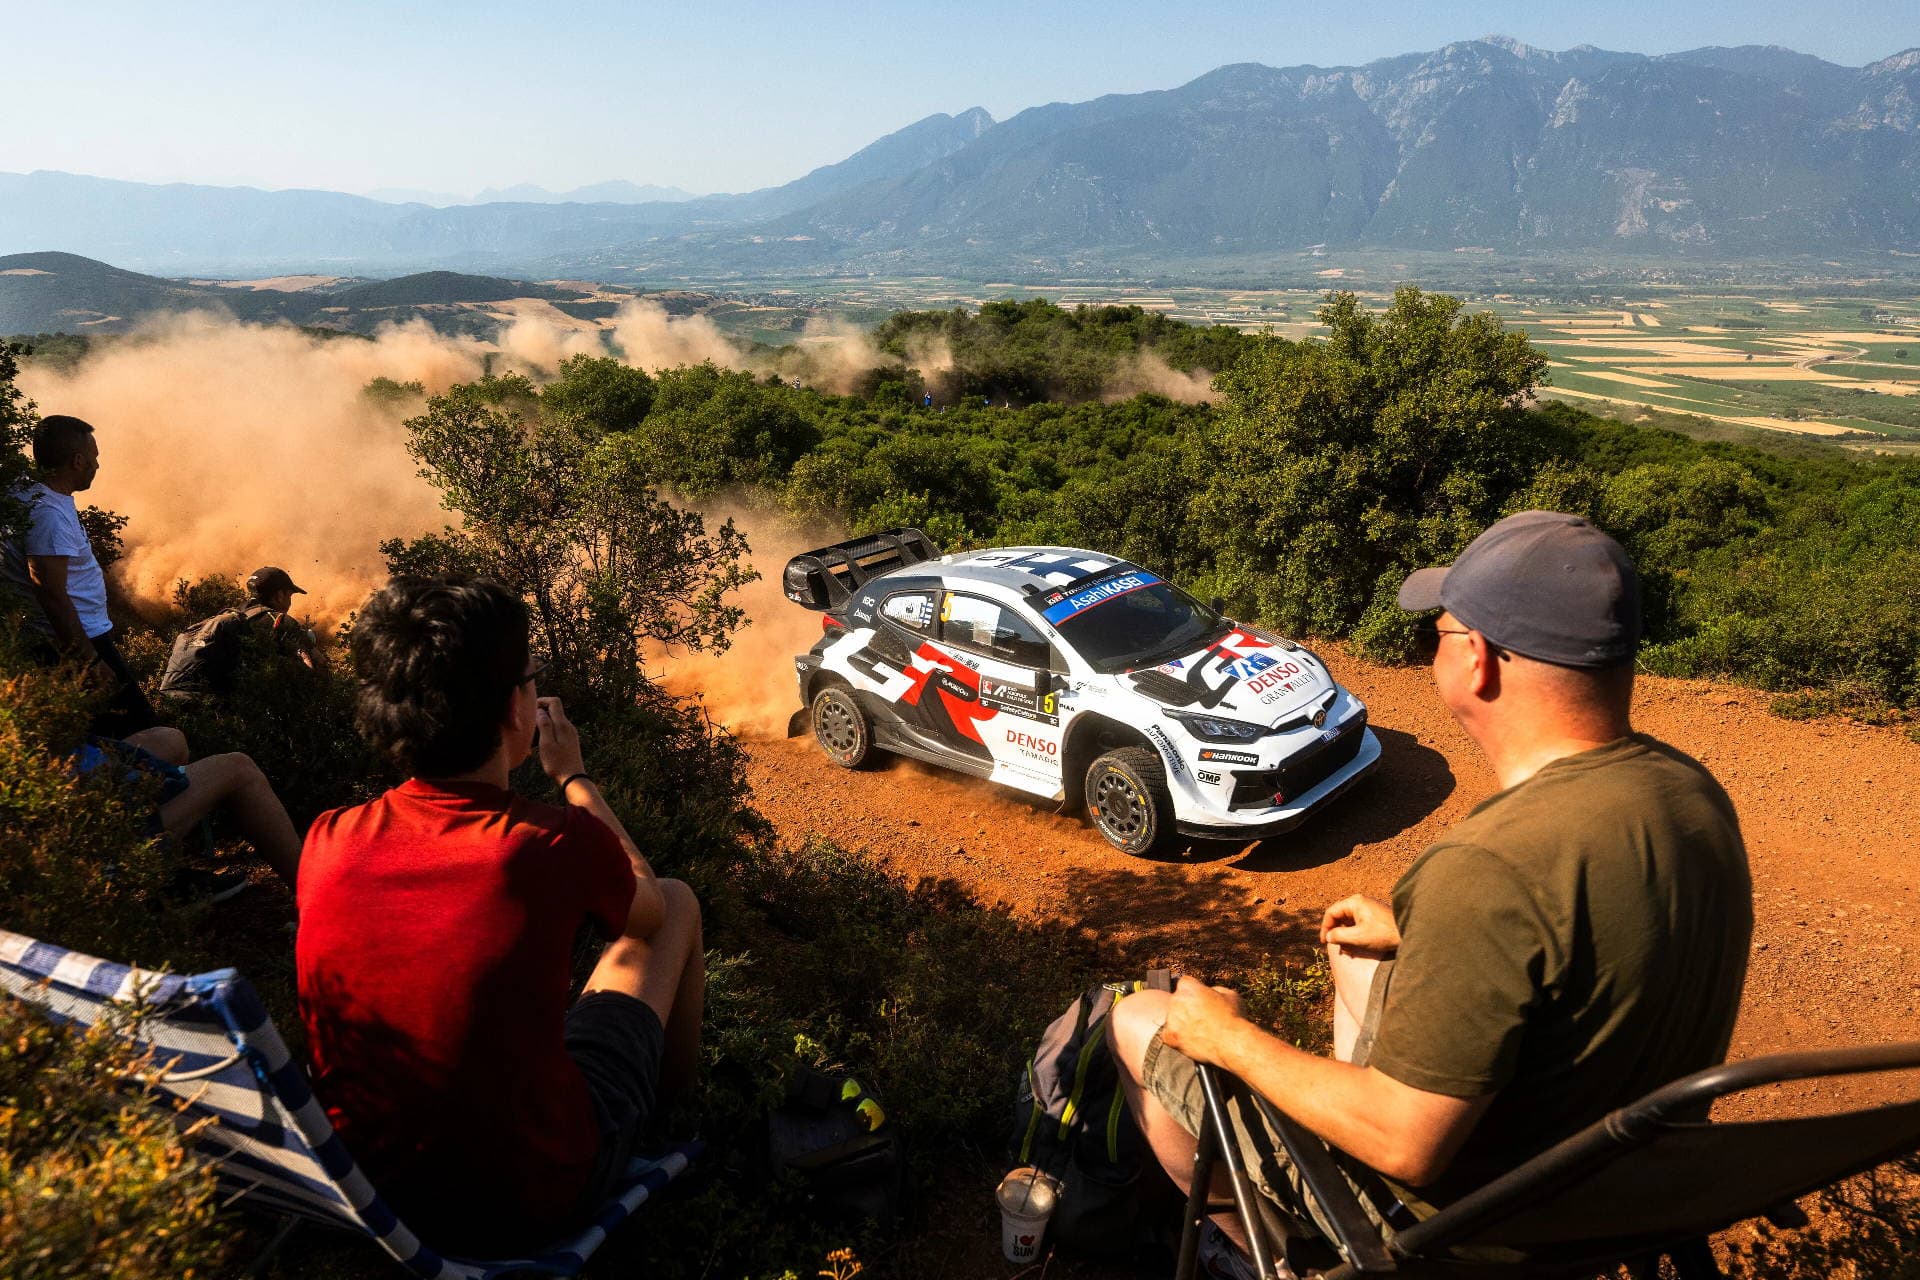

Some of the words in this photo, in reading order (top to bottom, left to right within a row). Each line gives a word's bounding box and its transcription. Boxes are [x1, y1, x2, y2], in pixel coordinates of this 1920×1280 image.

[1247, 662, 1299, 694] DENSO
[1043, 692, 1055, 714] 5
[1006, 729, 1057, 756] DENSO
[1197, 771, 1221, 784] OMP
